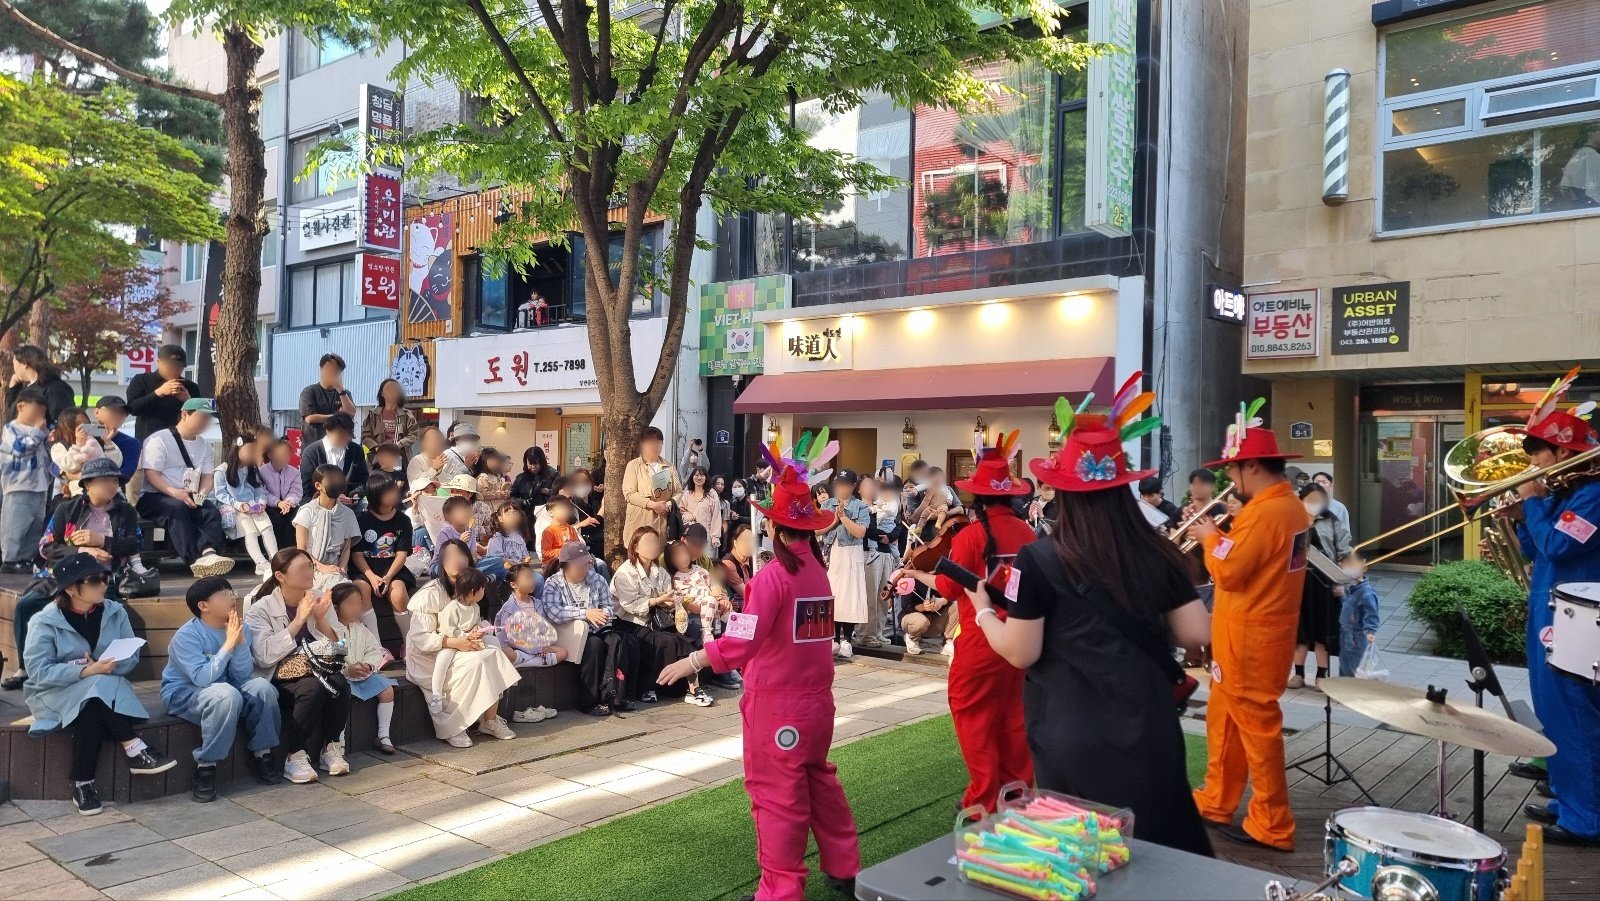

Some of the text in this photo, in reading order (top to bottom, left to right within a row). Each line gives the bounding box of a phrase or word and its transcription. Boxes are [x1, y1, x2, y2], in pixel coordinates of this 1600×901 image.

[371, 94, 393, 112] 청담
[371, 110, 393, 127] 명품
[381, 188, 397, 239] 우미관
[365, 276, 397, 301] 도원
[1343, 289, 1397, 305] URBAN
[1253, 298, 1312, 313] 아트에비뉴
[1343, 303, 1397, 318] ASSET
[714, 311, 754, 327] VIET-H
[1252, 313, 1313, 340] 부동산
[788, 334, 838, 361] 味道人
[1251, 342, 1312, 353] 010.8843.8263
[483, 351, 586, 386] 도원 T.255-7898
